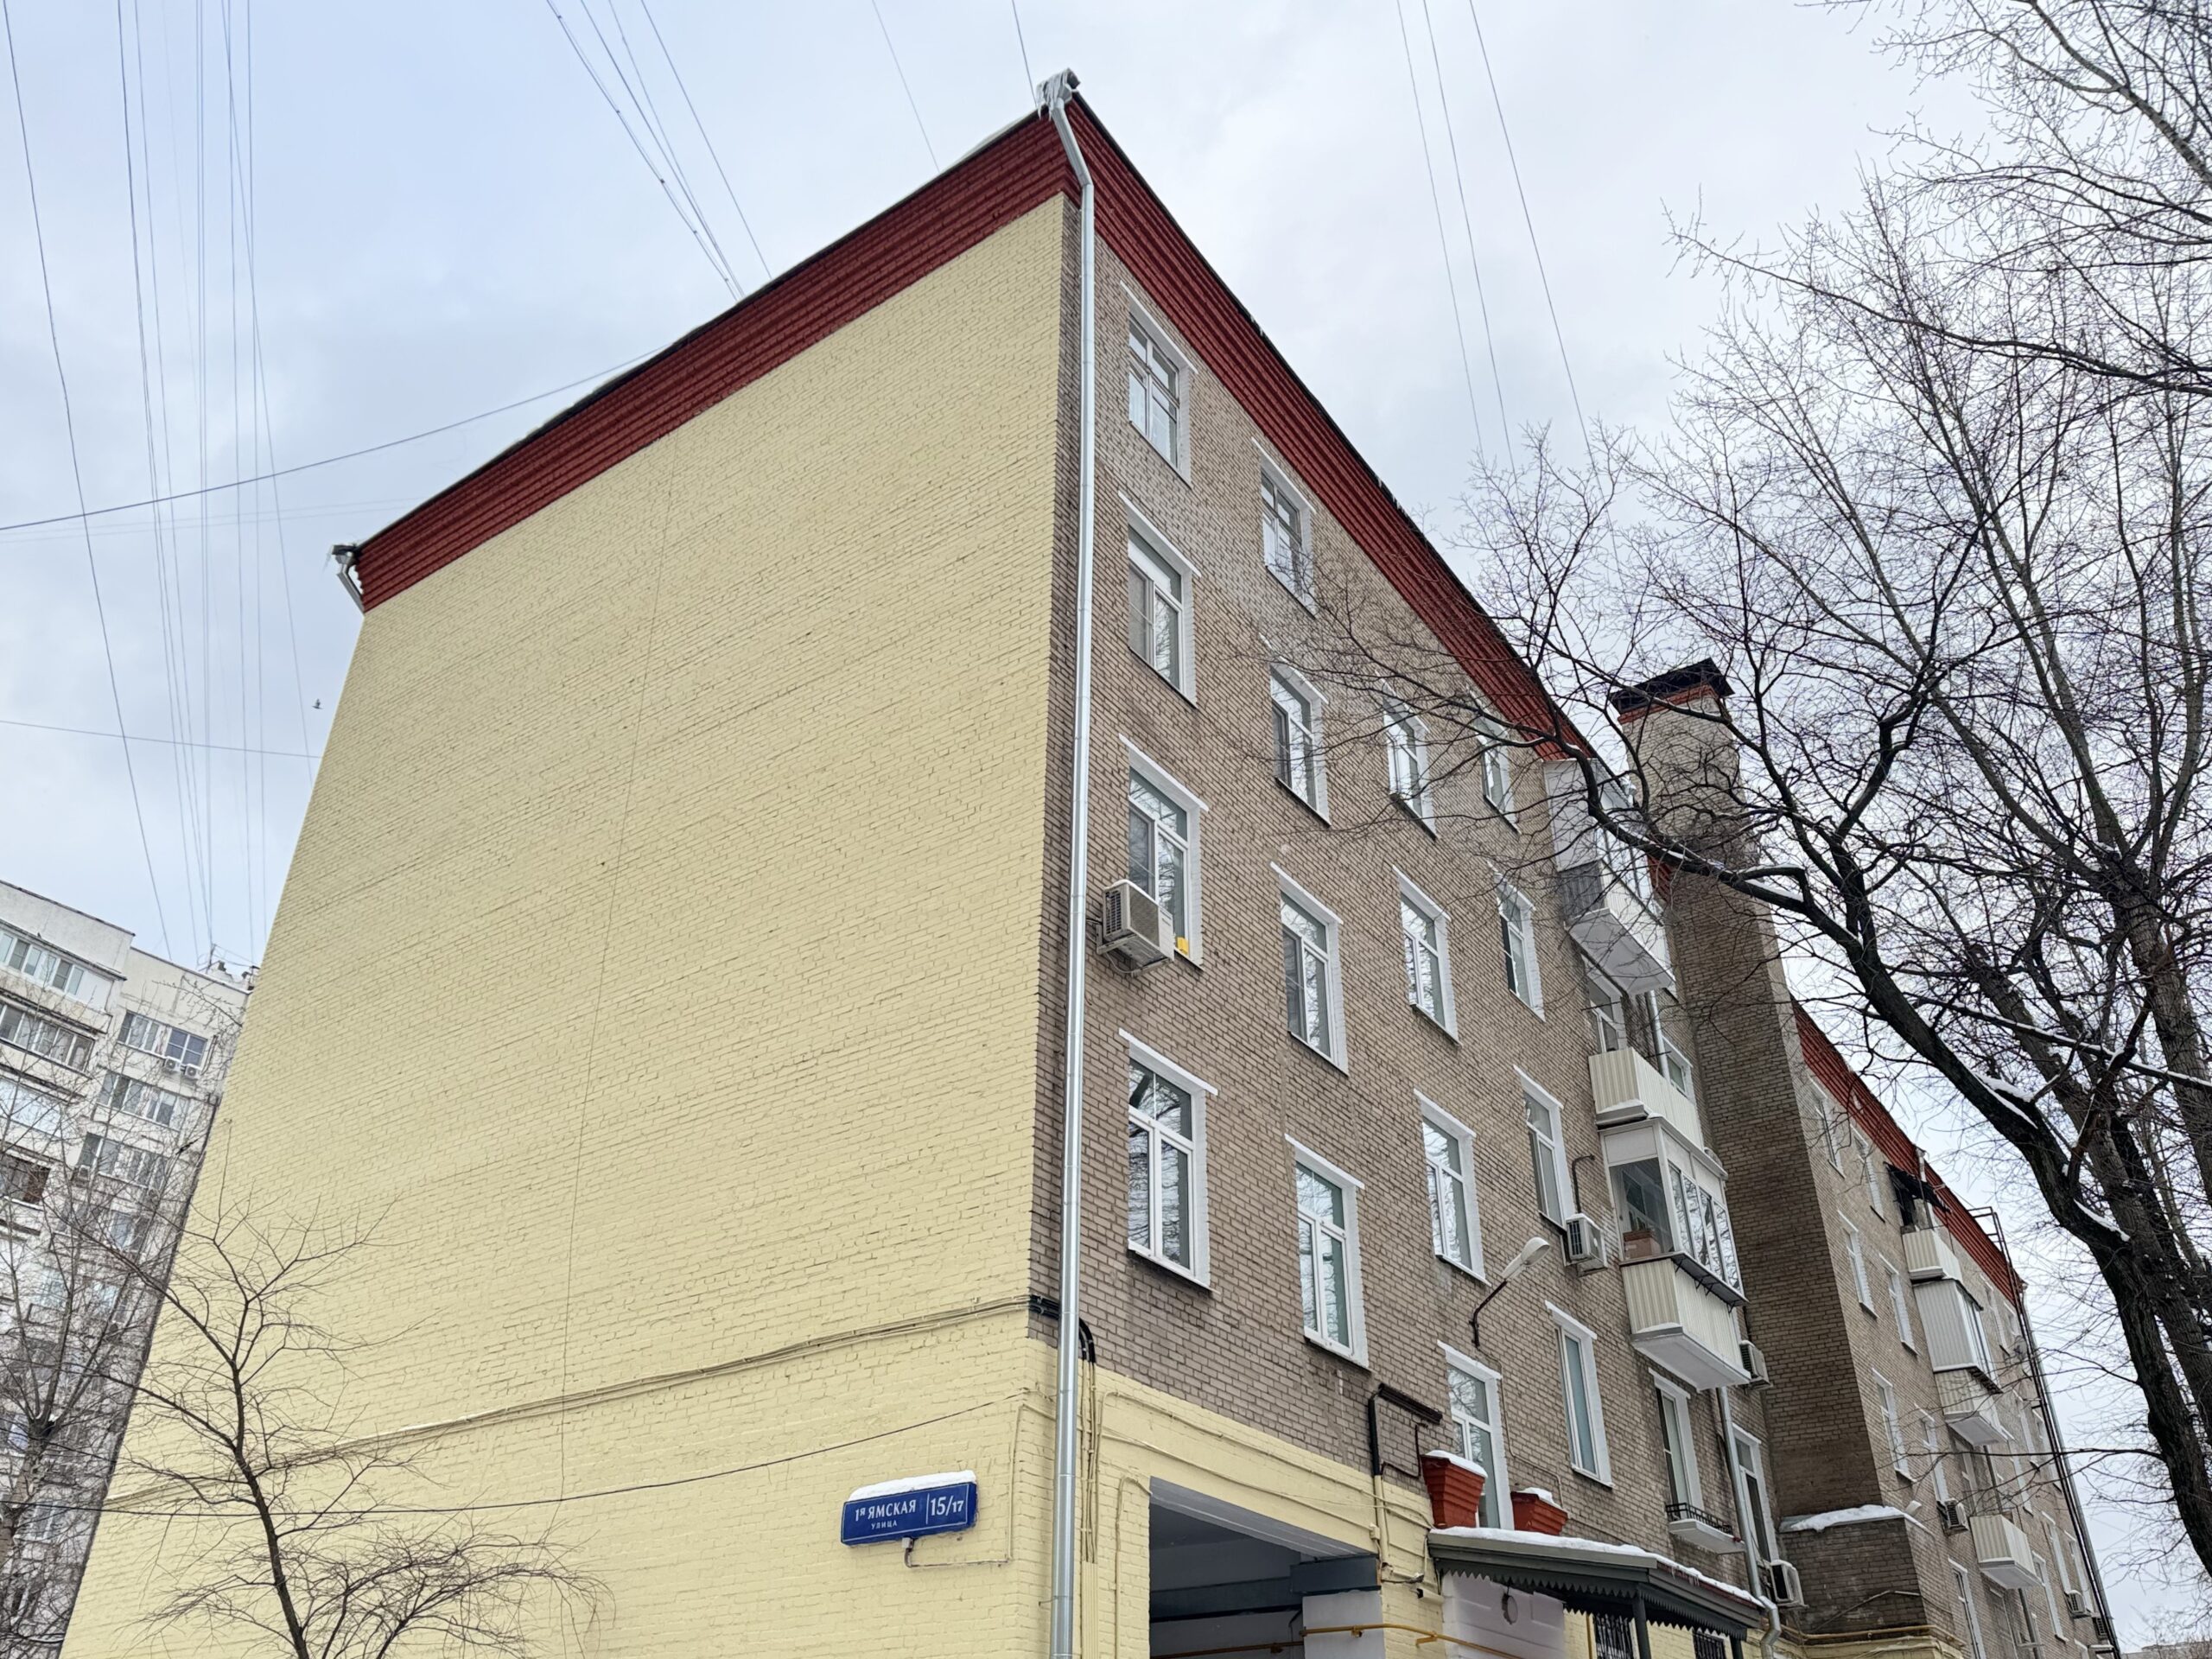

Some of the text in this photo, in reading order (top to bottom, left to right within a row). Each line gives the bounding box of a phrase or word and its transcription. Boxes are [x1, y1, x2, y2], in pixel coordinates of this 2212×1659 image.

[868, 1499, 917, 1520] ЯМСКАЯ
[930, 1495, 964, 1516] 15/17
[871, 1519, 898, 1530] УЛИЦА
